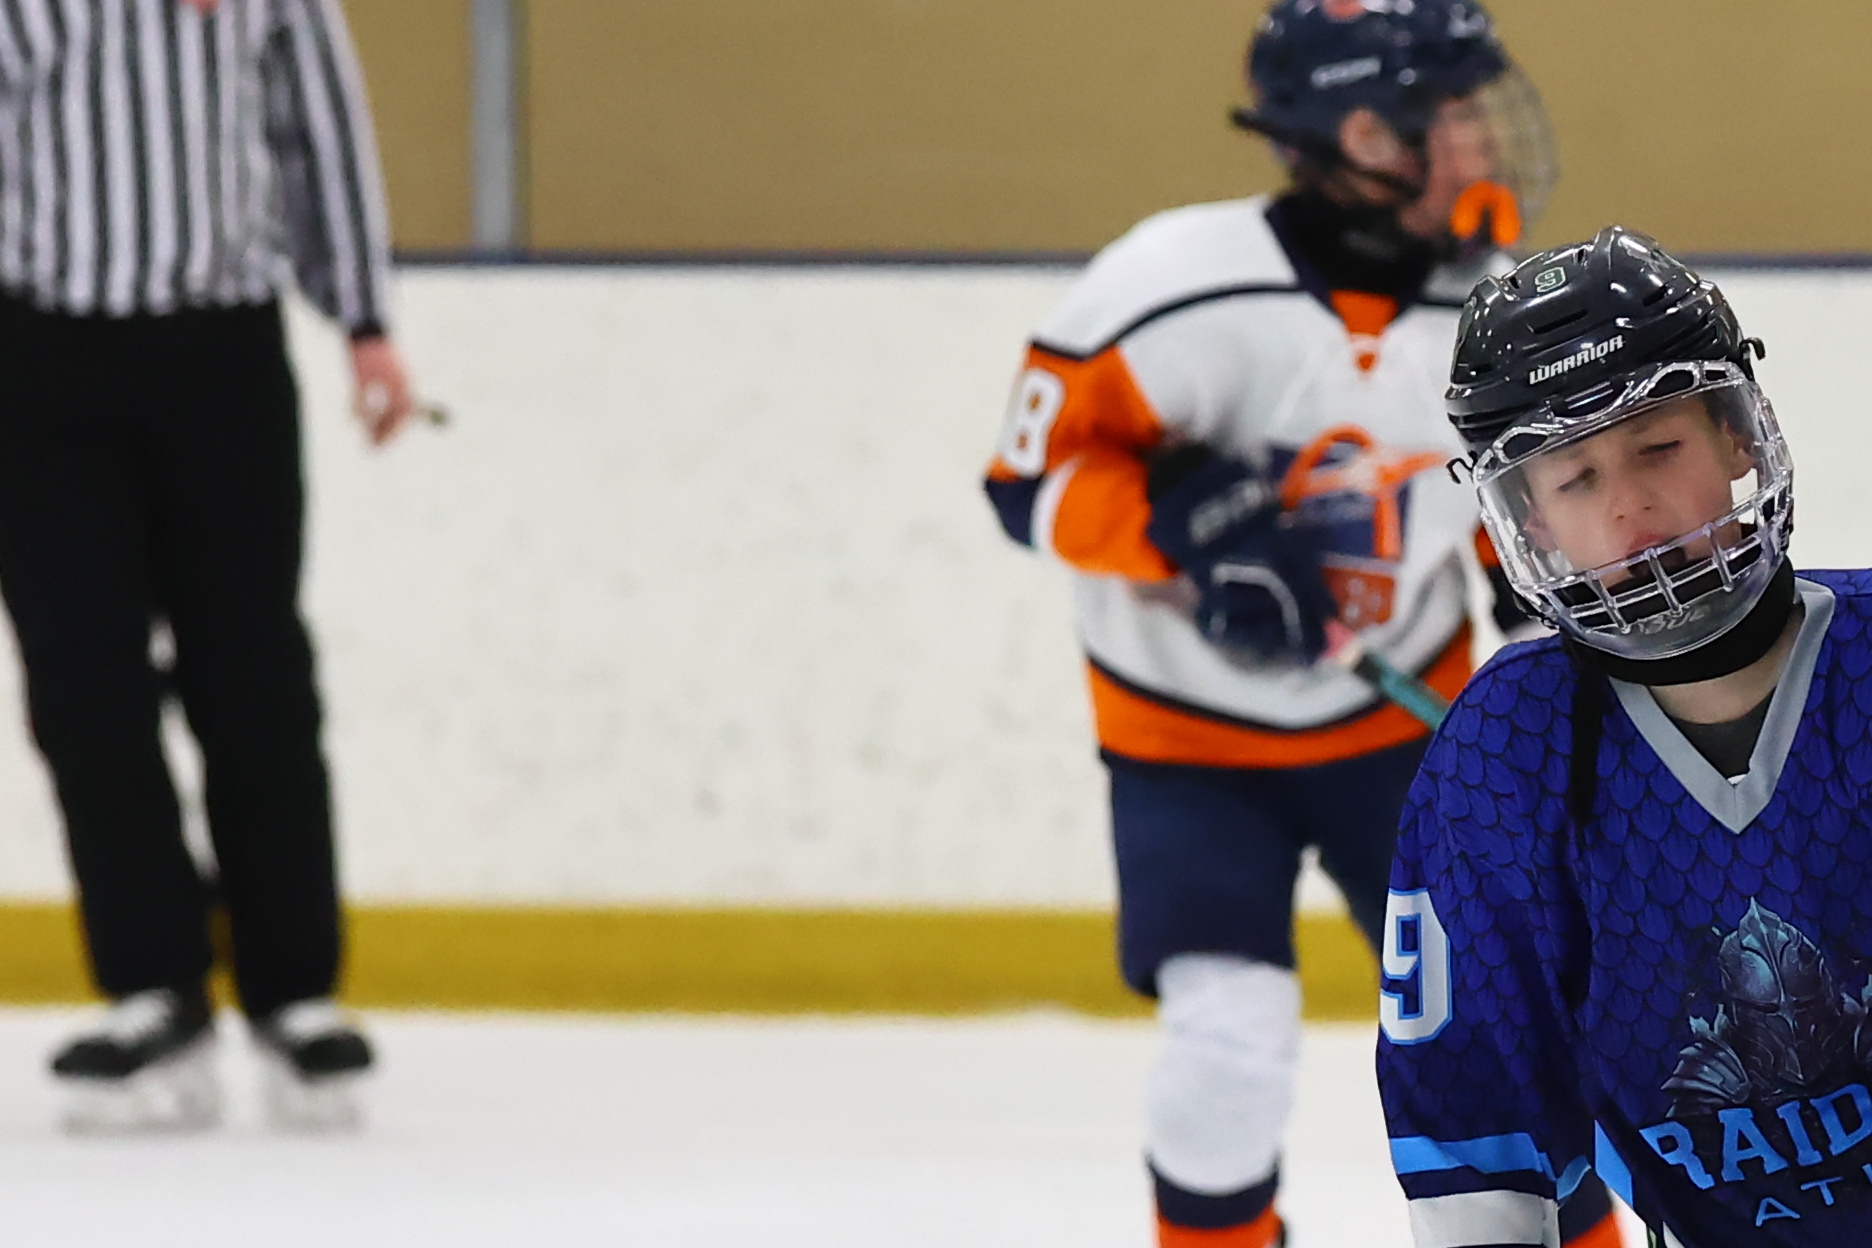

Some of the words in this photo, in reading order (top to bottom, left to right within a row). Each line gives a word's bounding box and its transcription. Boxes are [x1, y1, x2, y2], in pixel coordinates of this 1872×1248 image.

[1534, 266, 1567, 293] 9
[1529, 334, 1625, 385] WARRIOR
[1379, 887, 1453, 1046] 9
